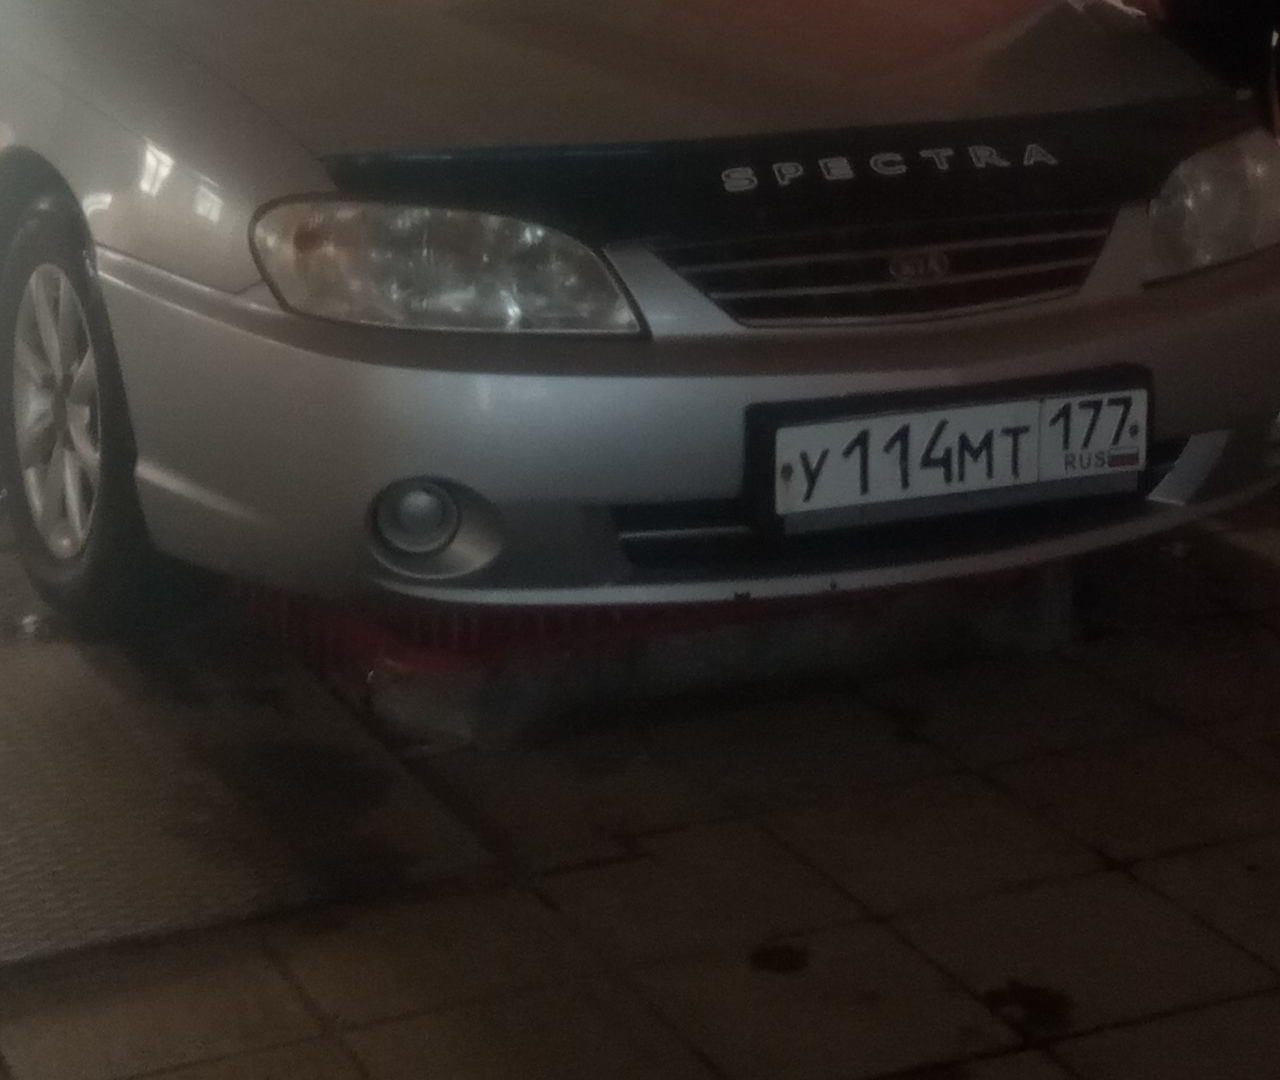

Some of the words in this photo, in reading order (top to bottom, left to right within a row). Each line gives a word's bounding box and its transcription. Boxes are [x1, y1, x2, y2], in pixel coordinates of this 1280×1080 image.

[720, 142, 1060, 193] SPECTRA
[1047, 395, 1133, 451] 177
[1064, 451, 1108, 472] RUS
